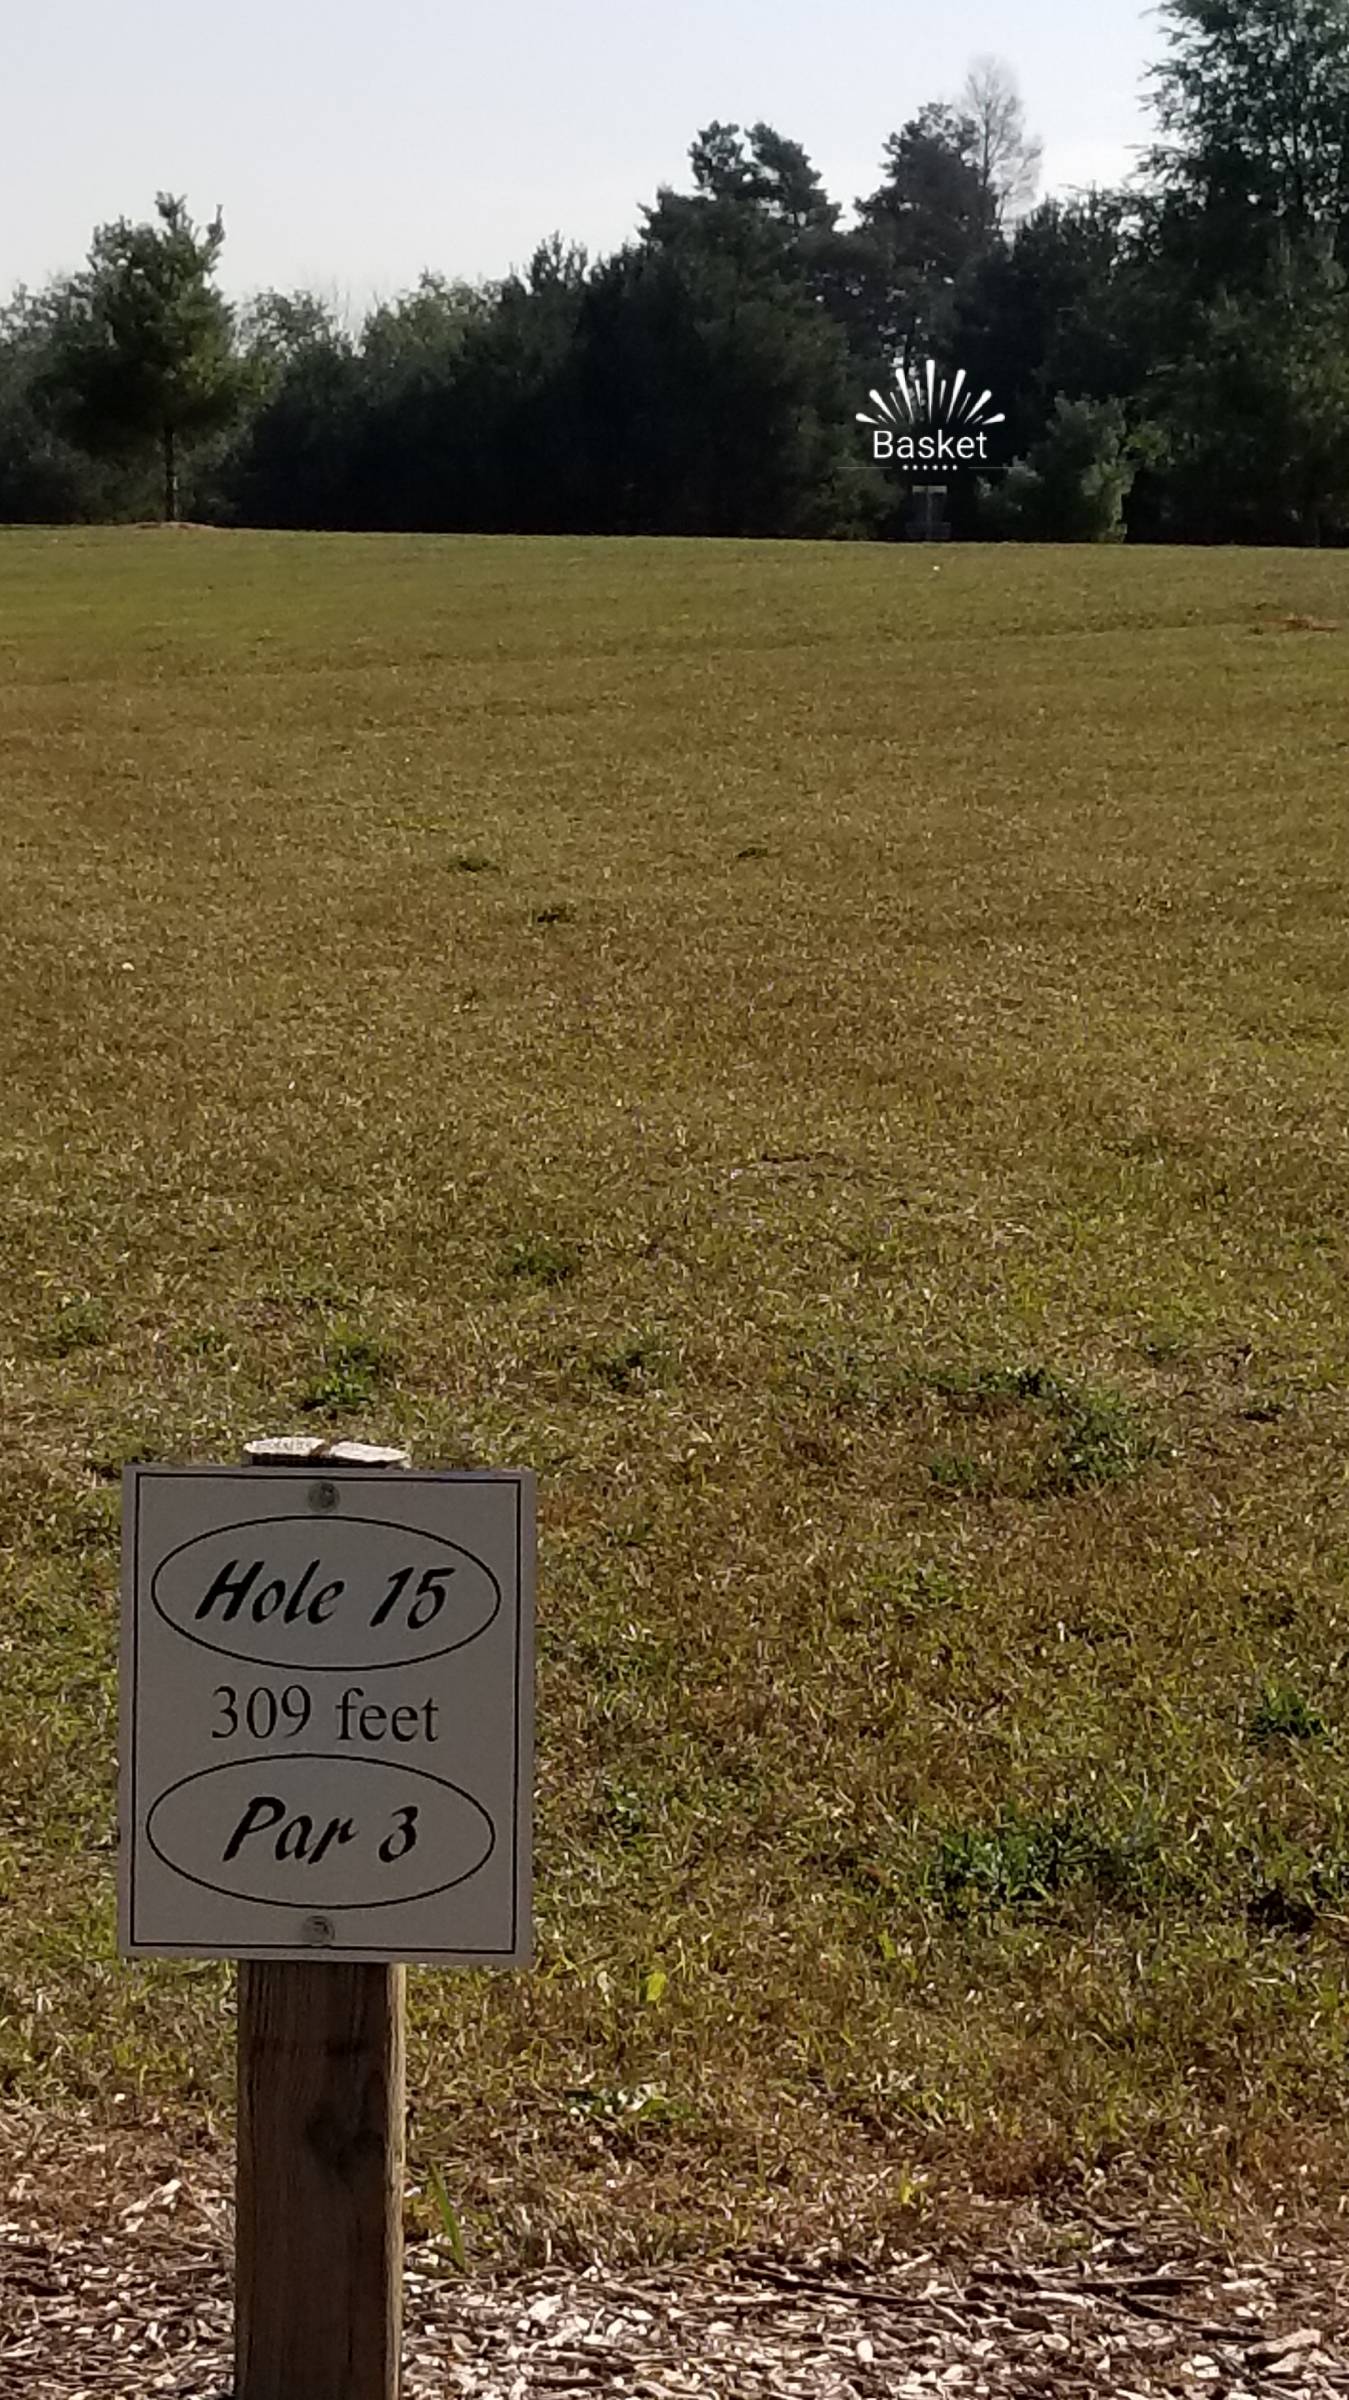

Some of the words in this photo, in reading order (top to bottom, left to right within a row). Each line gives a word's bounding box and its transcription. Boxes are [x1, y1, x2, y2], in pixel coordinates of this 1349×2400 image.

[195, 1559, 345, 1625] Hole
[370, 1566, 455, 1630] 15
[211, 1685, 312, 1739] 309
[335, 1687, 439, 1742] feet
[222, 1796, 359, 1865] Par
[378, 1806, 418, 1863] 3
